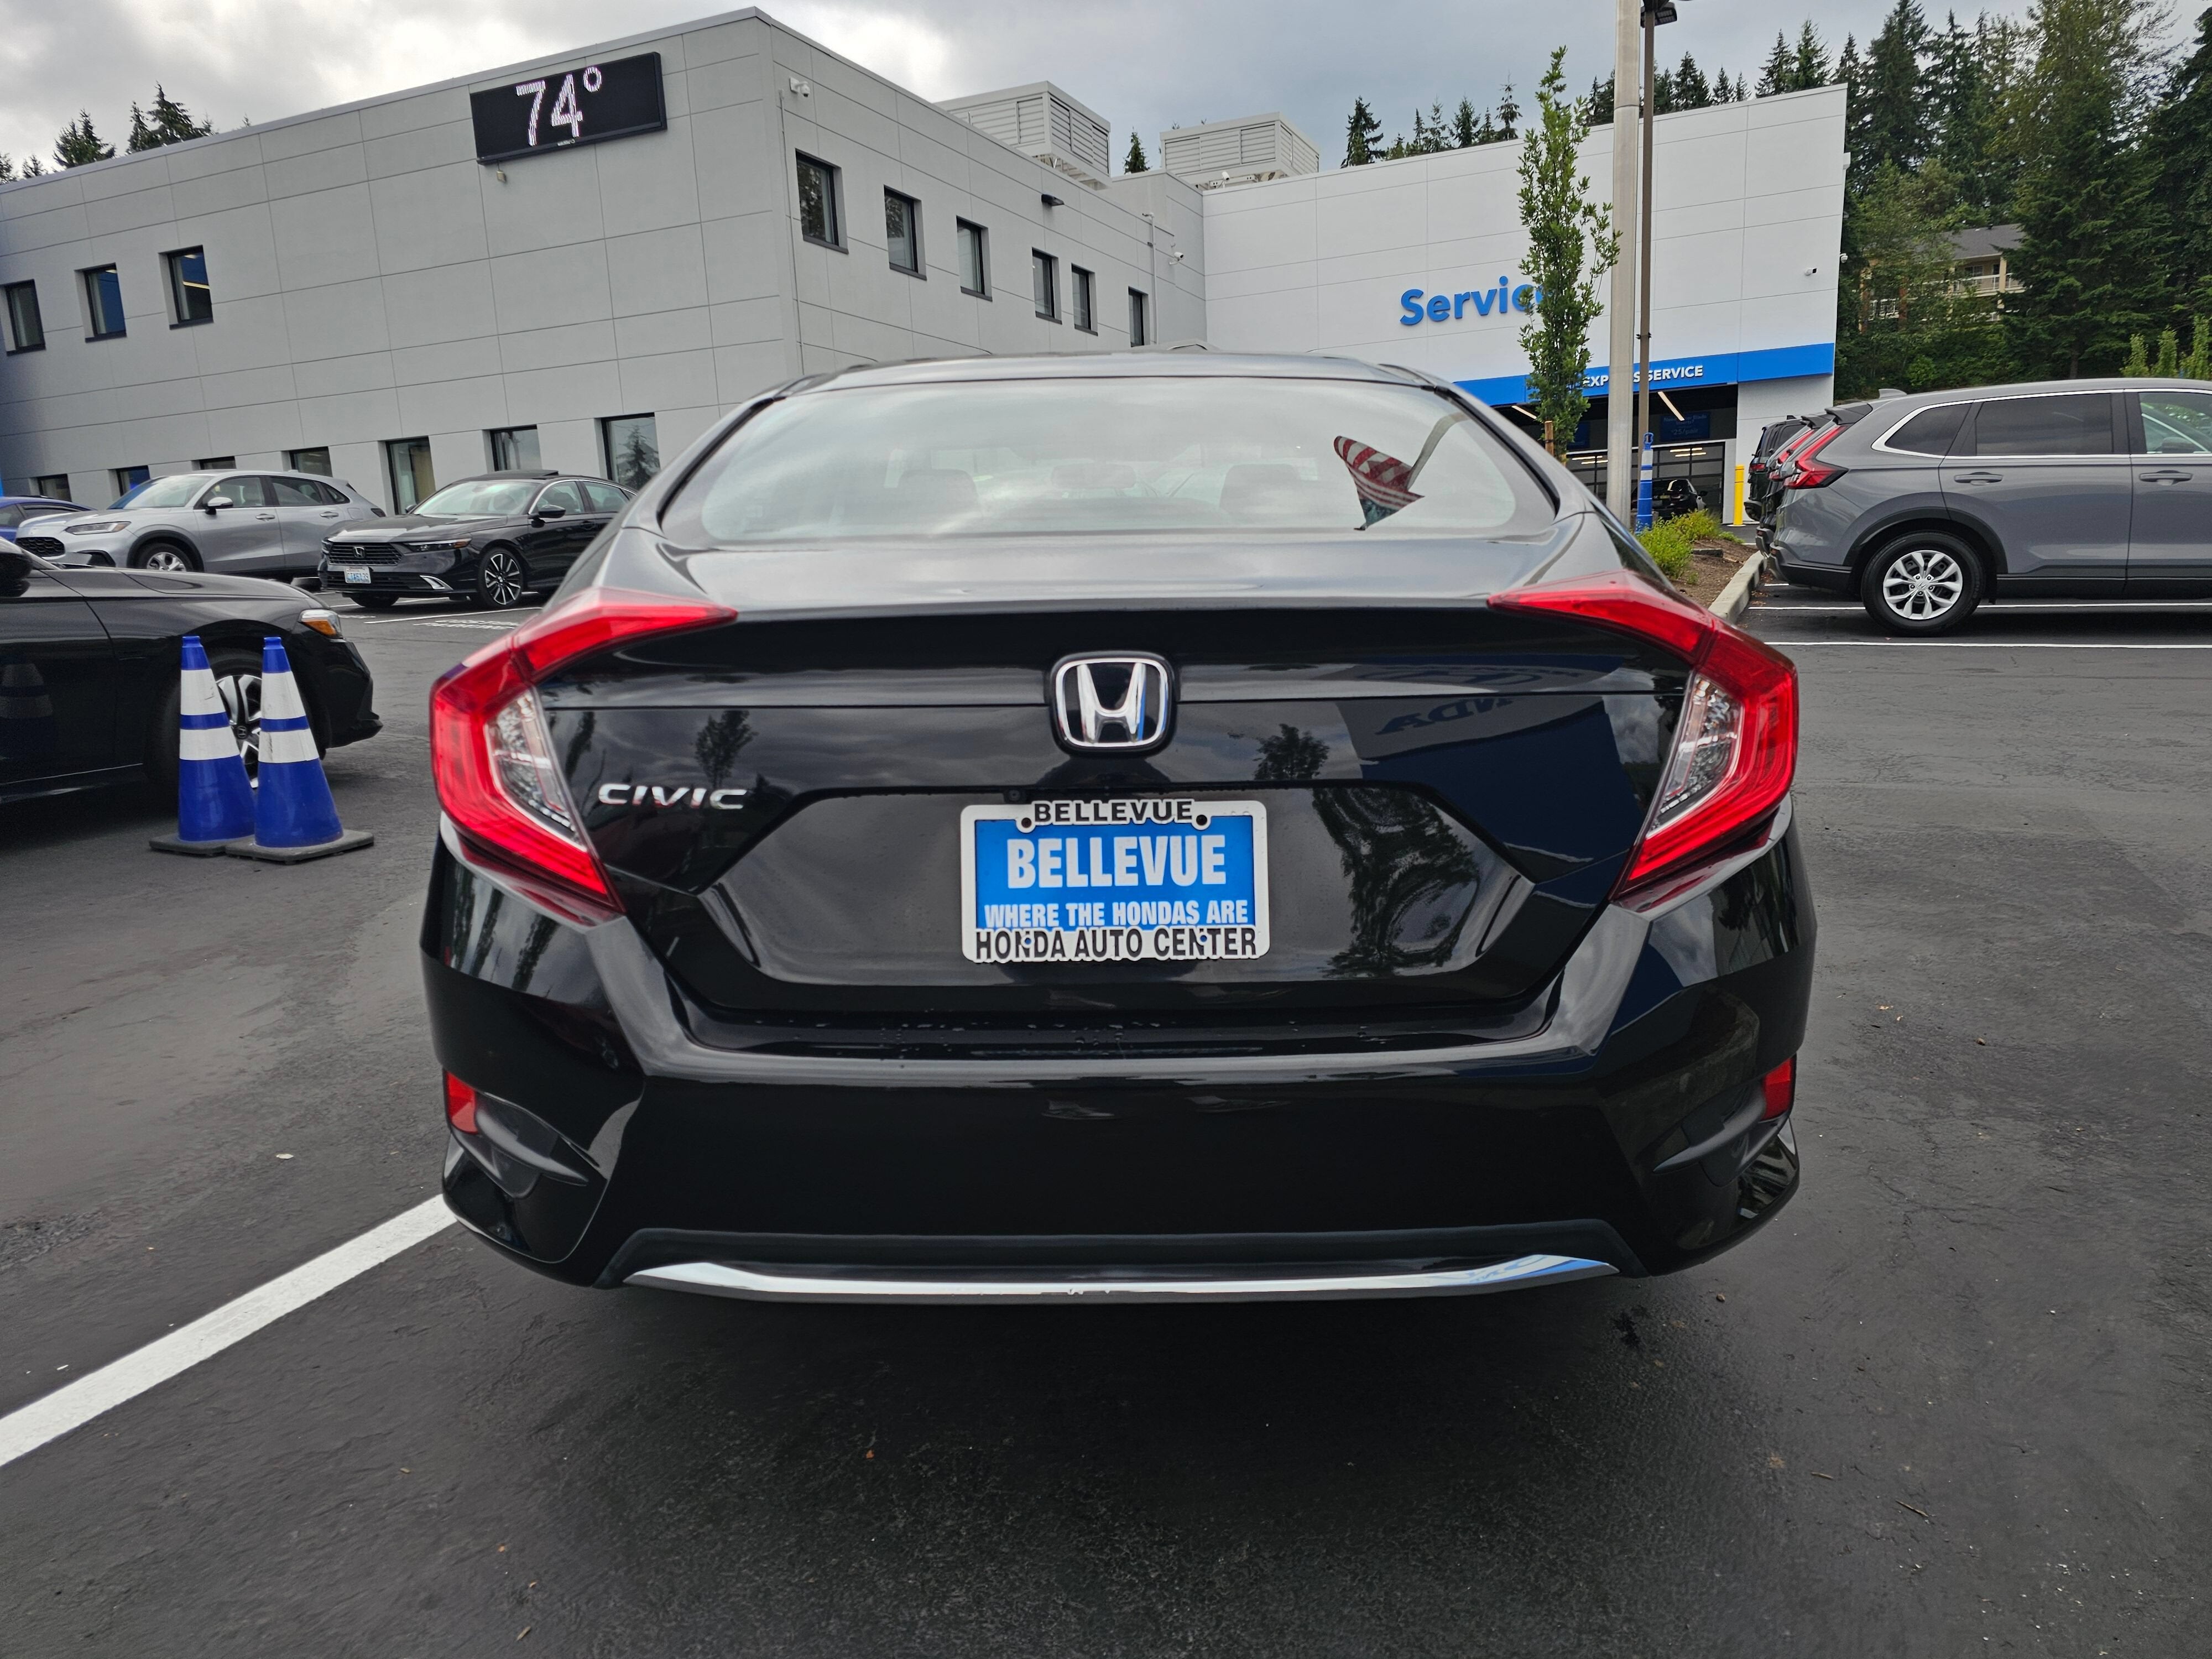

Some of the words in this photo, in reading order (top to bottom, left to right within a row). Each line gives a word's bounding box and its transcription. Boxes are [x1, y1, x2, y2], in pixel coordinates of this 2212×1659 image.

[1400, 276, 1552, 325] Servic
[1583, 371, 1641, 387] EXPS
[598, 783, 747, 809] CIVIC
[1034, 801, 1192, 822] BELLEVUE
[1006, 835, 1227, 889] BELLEVUE
[984, 904, 1059, 928] WHERE
[1066, 902, 1105, 927] THE
[1112, 901, 1199, 926] HONDAS
[1206, 900, 1248, 924] ARE
[976, 930, 1065, 959] HONDA
[1074, 928, 1143, 958] AUTO
[1154, 927, 1256, 956] CENTER
